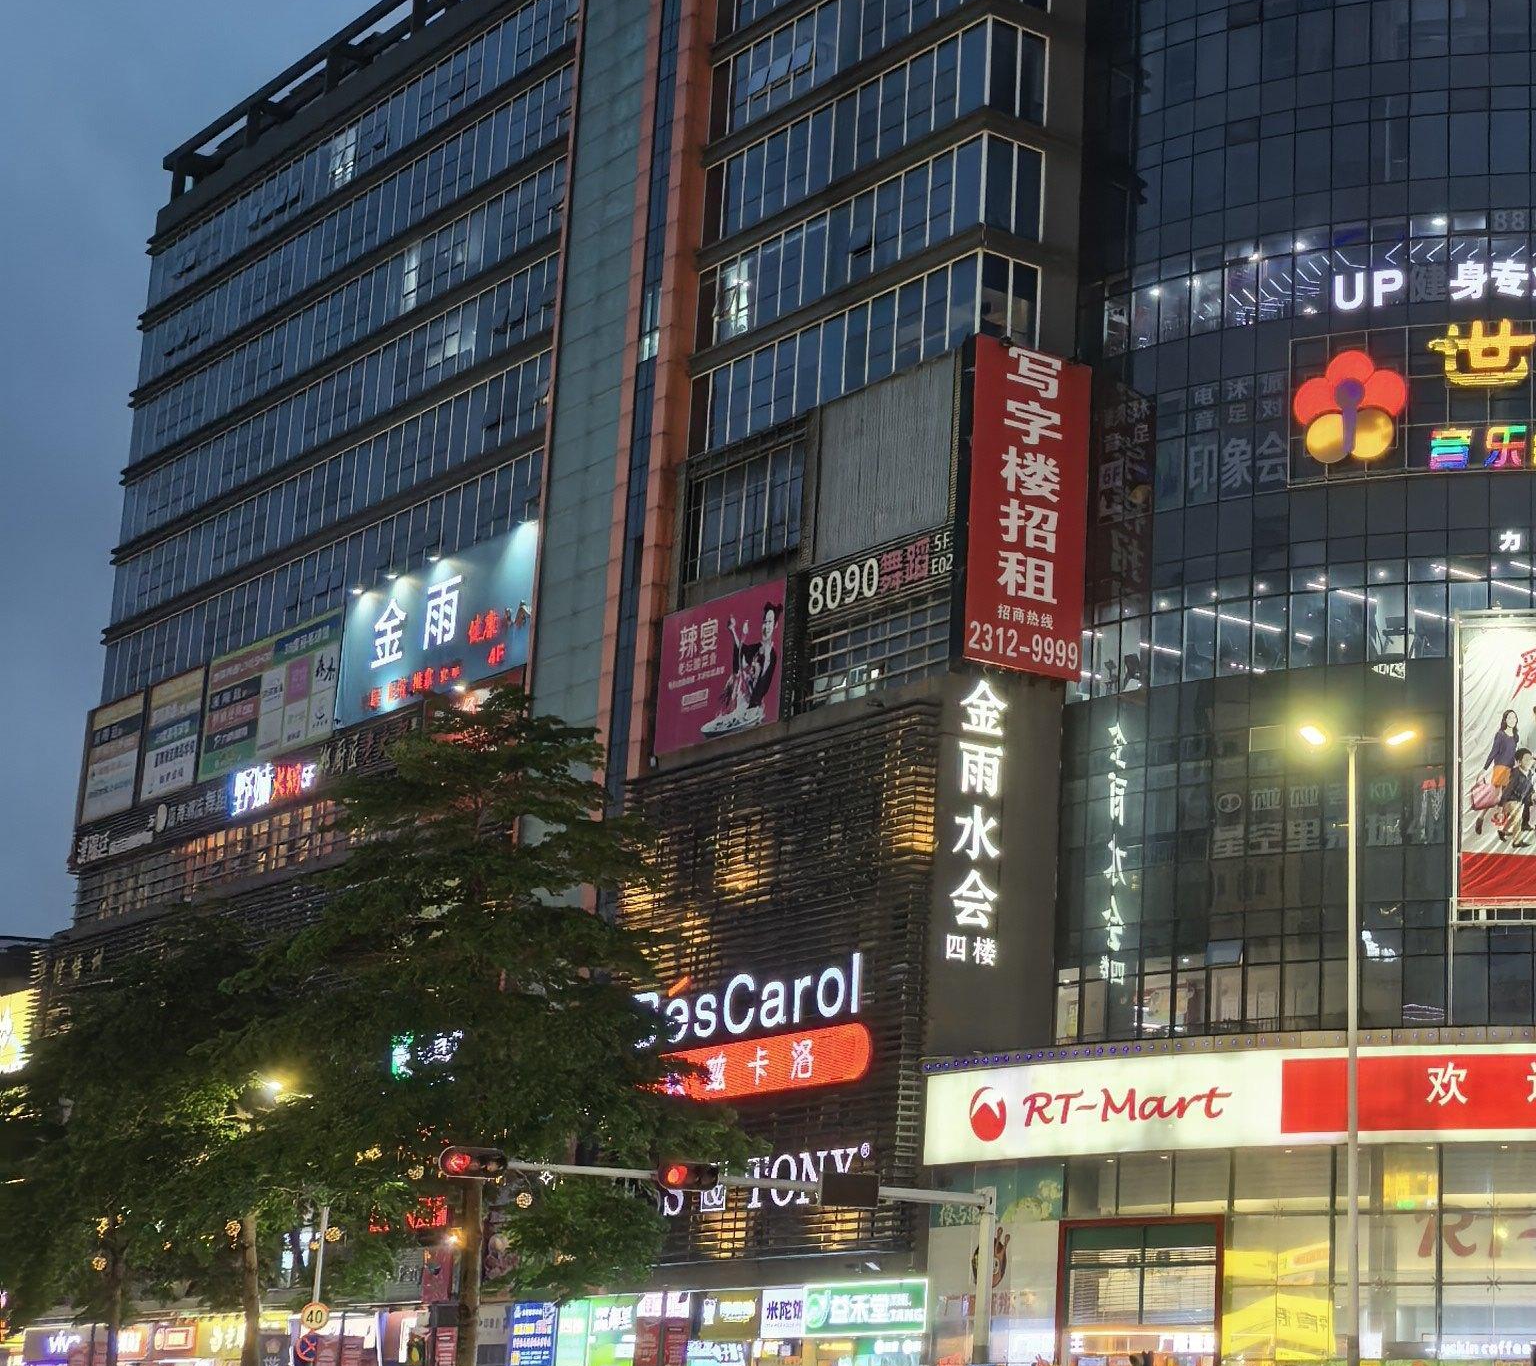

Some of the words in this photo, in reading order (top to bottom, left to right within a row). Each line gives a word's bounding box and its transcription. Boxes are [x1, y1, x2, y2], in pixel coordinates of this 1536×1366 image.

[998, 345, 1063, 606] 写字楼招租
[370, 575, 463, 669] 金雨
[997, 603, 1055, 630] 招商热线
[968, 620, 1080, 671] 2312-9999
[950, 679, 1010, 929] 金雨水会
[945, 934, 997, 967] 四楼
[1023, 1085, 1233, 1130] RT-Mart
[306, 1310, 323, 1325] 40
